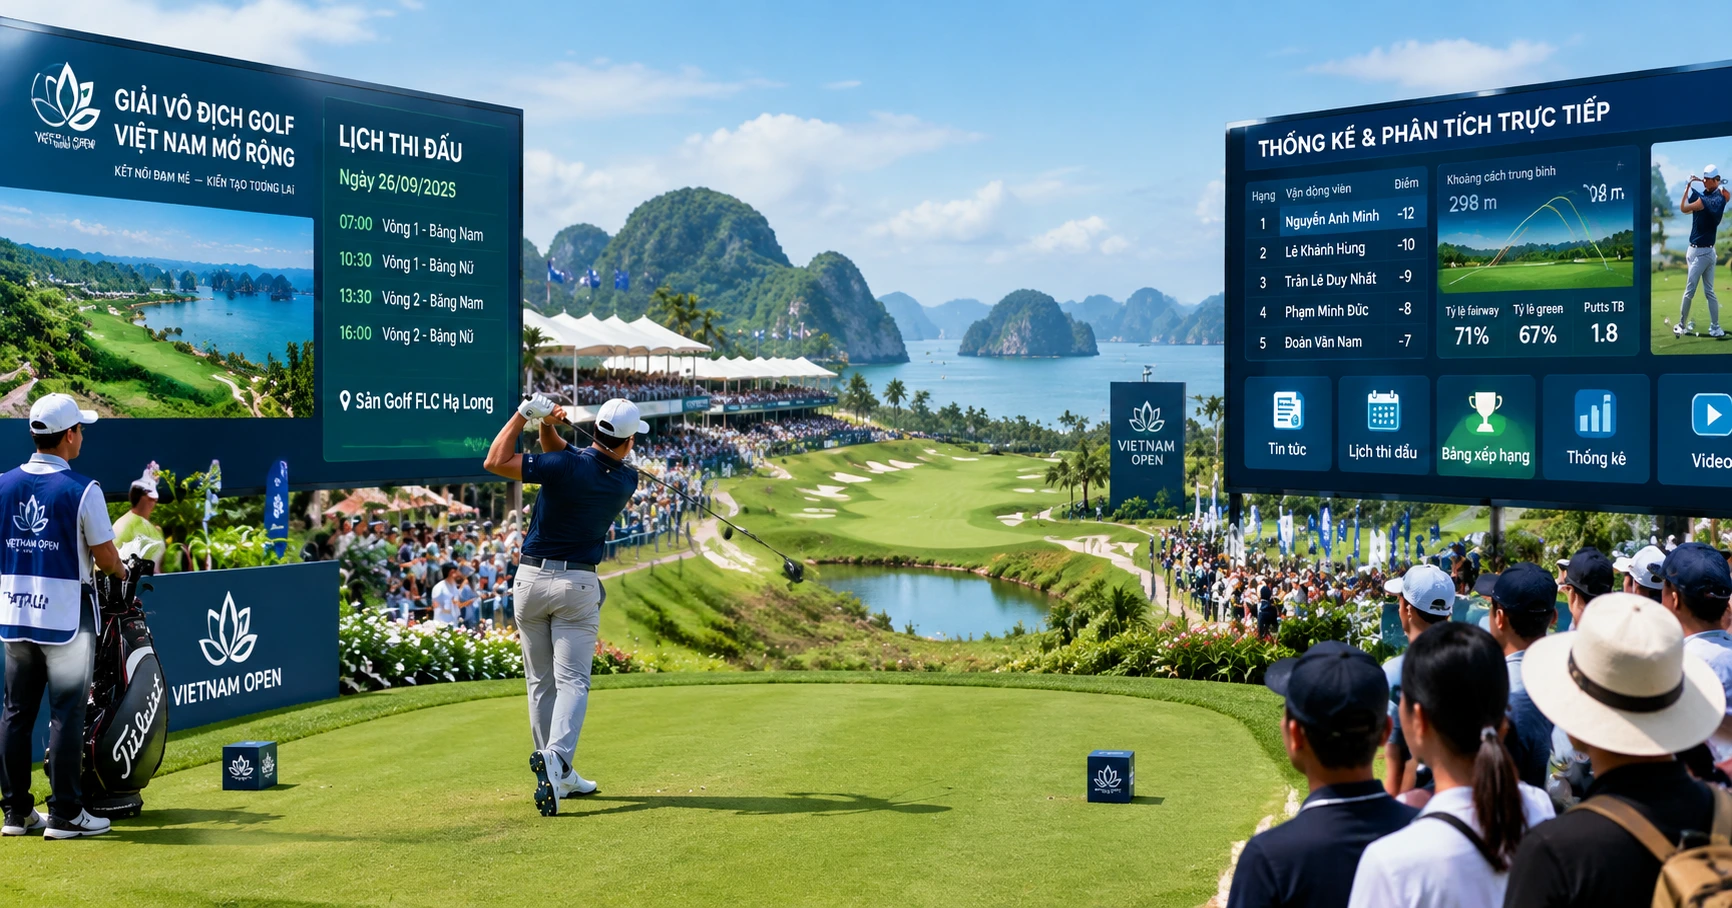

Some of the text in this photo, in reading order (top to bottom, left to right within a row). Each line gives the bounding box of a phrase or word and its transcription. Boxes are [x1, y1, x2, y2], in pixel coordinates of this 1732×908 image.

[114, 84, 295, 136] GIẢI VÔ ĐỊCH GOLF
[1361, 128, 1377, 148] &
[1381, 117, 1439, 145] PHÂN
[1497, 105, 1558, 136] TRỰC
[1562, 94, 1612, 126] TIẾP
[113, 121, 159, 155] VIỆT
[163, 130, 207, 157] NAM
[245, 138, 295, 170] RỘNG
[339, 123, 463, 163] LỊCH THI ĐẤU
[1483, 170, 1507, 184] cách
[1508, 169, 1534, 181] trung
[1448, 194, 1498, 214] 298 m
[339, 214, 373, 231] 07:00
[413, 221, 419, 236] 1
[459, 226, 484, 242] Nam
[1260, 217, 1266, 230] 1
[1327, 212, 1350, 226] Anh
[1352, 208, 1380, 224] Minh
[1397, 206, 1416, 222] -12
[1260, 247, 1268, 260] 2
[1397, 237, 1416, 252] -10
[339, 250, 373, 268] 10:30
[413, 256, 419, 271] 1
[1260, 276, 1268, 290] 3
[1326, 273, 1348, 289] Duy
[1398, 269, 1413, 284] -9
[339, 288, 373, 305] 13:30
[413, 292, 421, 307] 2
[459, 295, 484, 310] Nam
[1583, 300, 1625, 314] Putts TB
[1259, 306, 1268, 320] 4
[1285, 305, 1316, 322] Phạm
[1317, 304, 1345, 318] Minh
[1398, 302, 1413, 317] -8
[1467, 304, 1501, 318] fairway
[1536, 304, 1565, 317] green
[339, 325, 373, 341] 16:00
[413, 327, 421, 342] 2
[1259, 337, 1268, 351] 5
[1337, 335, 1364, 349] Nam
[1398, 334, 1413, 349] -7
[1454, 325, 1490, 346] 71%
[1518, 324, 1558, 345] 67%
[1590, 322, 1620, 344] 1.8
[415, 392, 441, 410] FLC
[462, 393, 495, 415] Long
[1117, 440, 1175, 452] VIETNAM
[1268, 442, 1286, 455] Tin
[1375, 444, 1393, 458] thi
[1131, 454, 1164, 466] OPEN
[1500, 449, 1532, 466] hạng
[171, 667, 283, 707] VIETNAM OPEN
